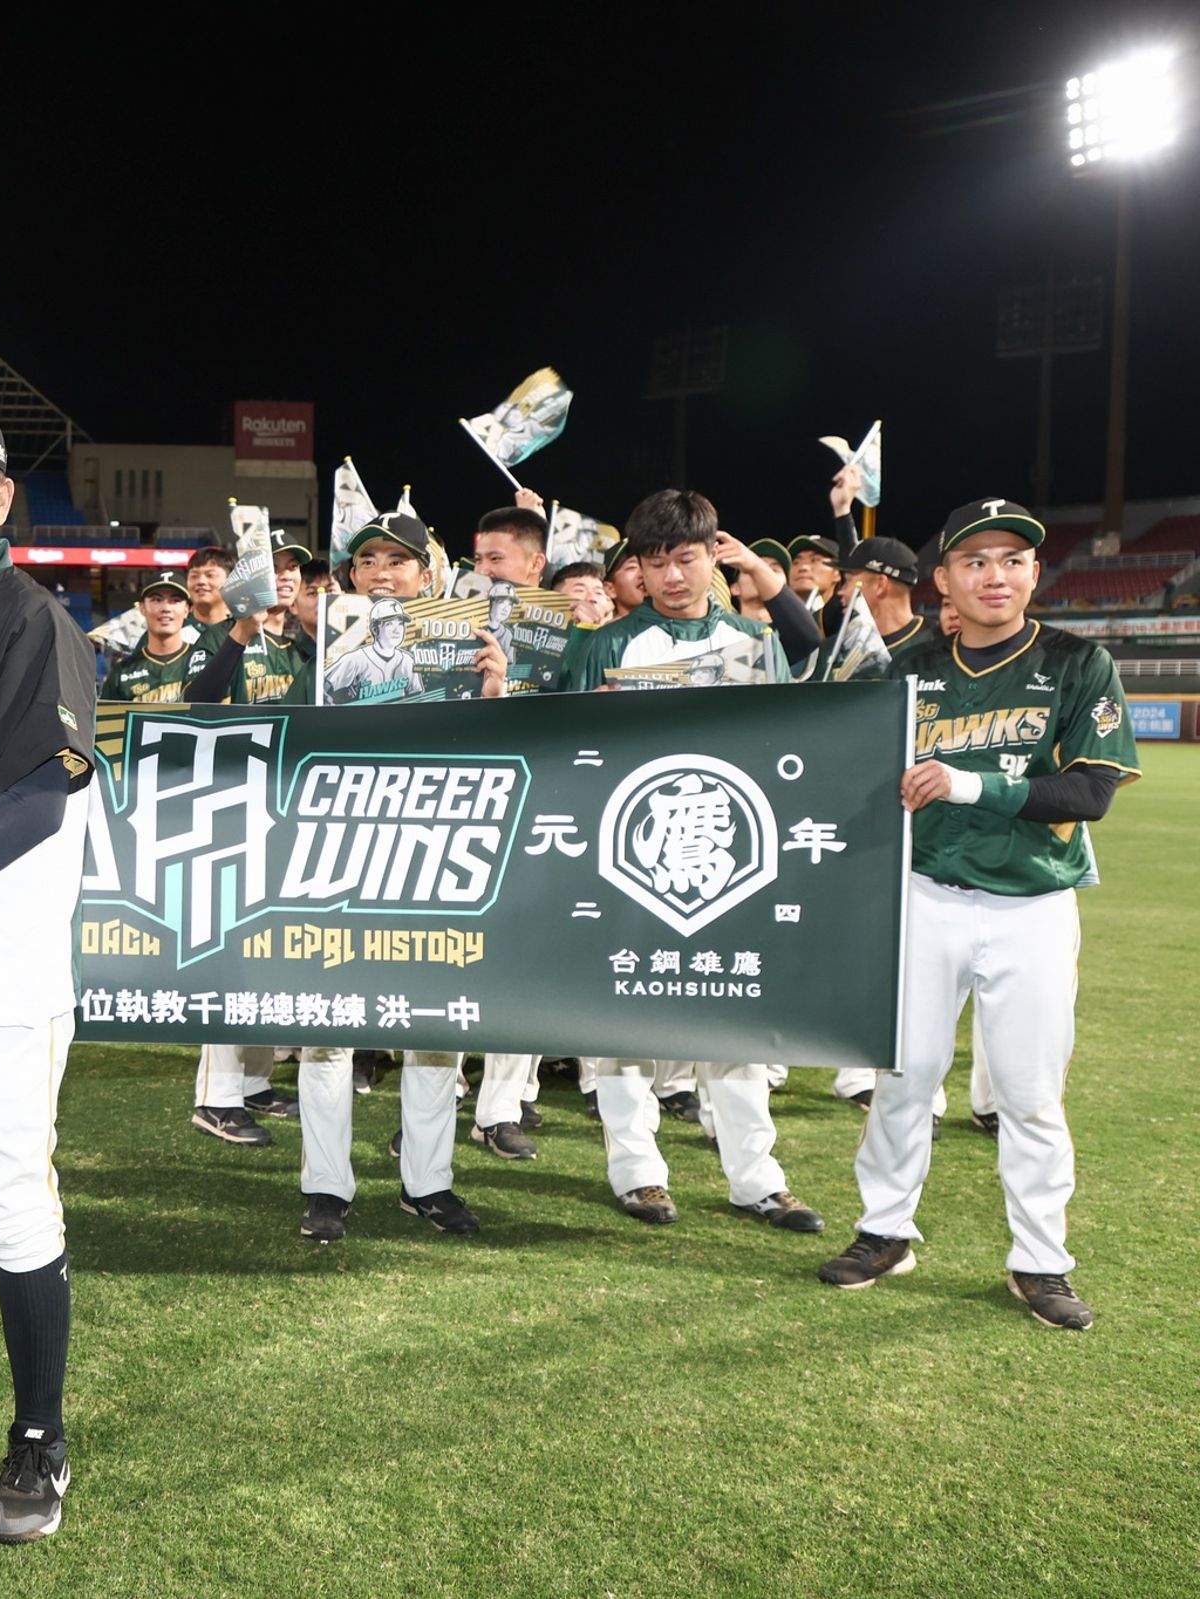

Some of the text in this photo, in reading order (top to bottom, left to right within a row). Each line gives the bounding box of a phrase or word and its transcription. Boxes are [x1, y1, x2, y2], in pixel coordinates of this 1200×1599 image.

[242, 416, 307, 433] Rakuten
[981, 499, 1006, 517] T
[379, 512, 401, 530] T
[526, 605, 565, 627] 1000
[423, 620, 471, 638] 1000
[513, 622, 533, 644] 1000
[410, 643, 439, 665] 1000
[358, 677, 409, 700] HAWKS
[916, 678, 948, 692] ink
[915, 698, 941, 723] SG
[573, 750, 604, 766] 二
[297, 765, 516, 820] CAREER
[524, 815, 588, 857] 元
[782, 817, 847, 864] 年
[279, 822, 502, 902] WINS
[571, 902, 602, 919] 二
[774, 904, 801, 922] 四
[81, 919, 484, 969] OACH IN CPBL HISTORY
[609, 949, 762, 976] 台鋼雄鷹
[614, 980, 762, 998] KAOHSIUNG
[81, 989, 481, 1031] 位執教千勝總教練 洪一中
[24, 1428, 46, 1440] NIKE
